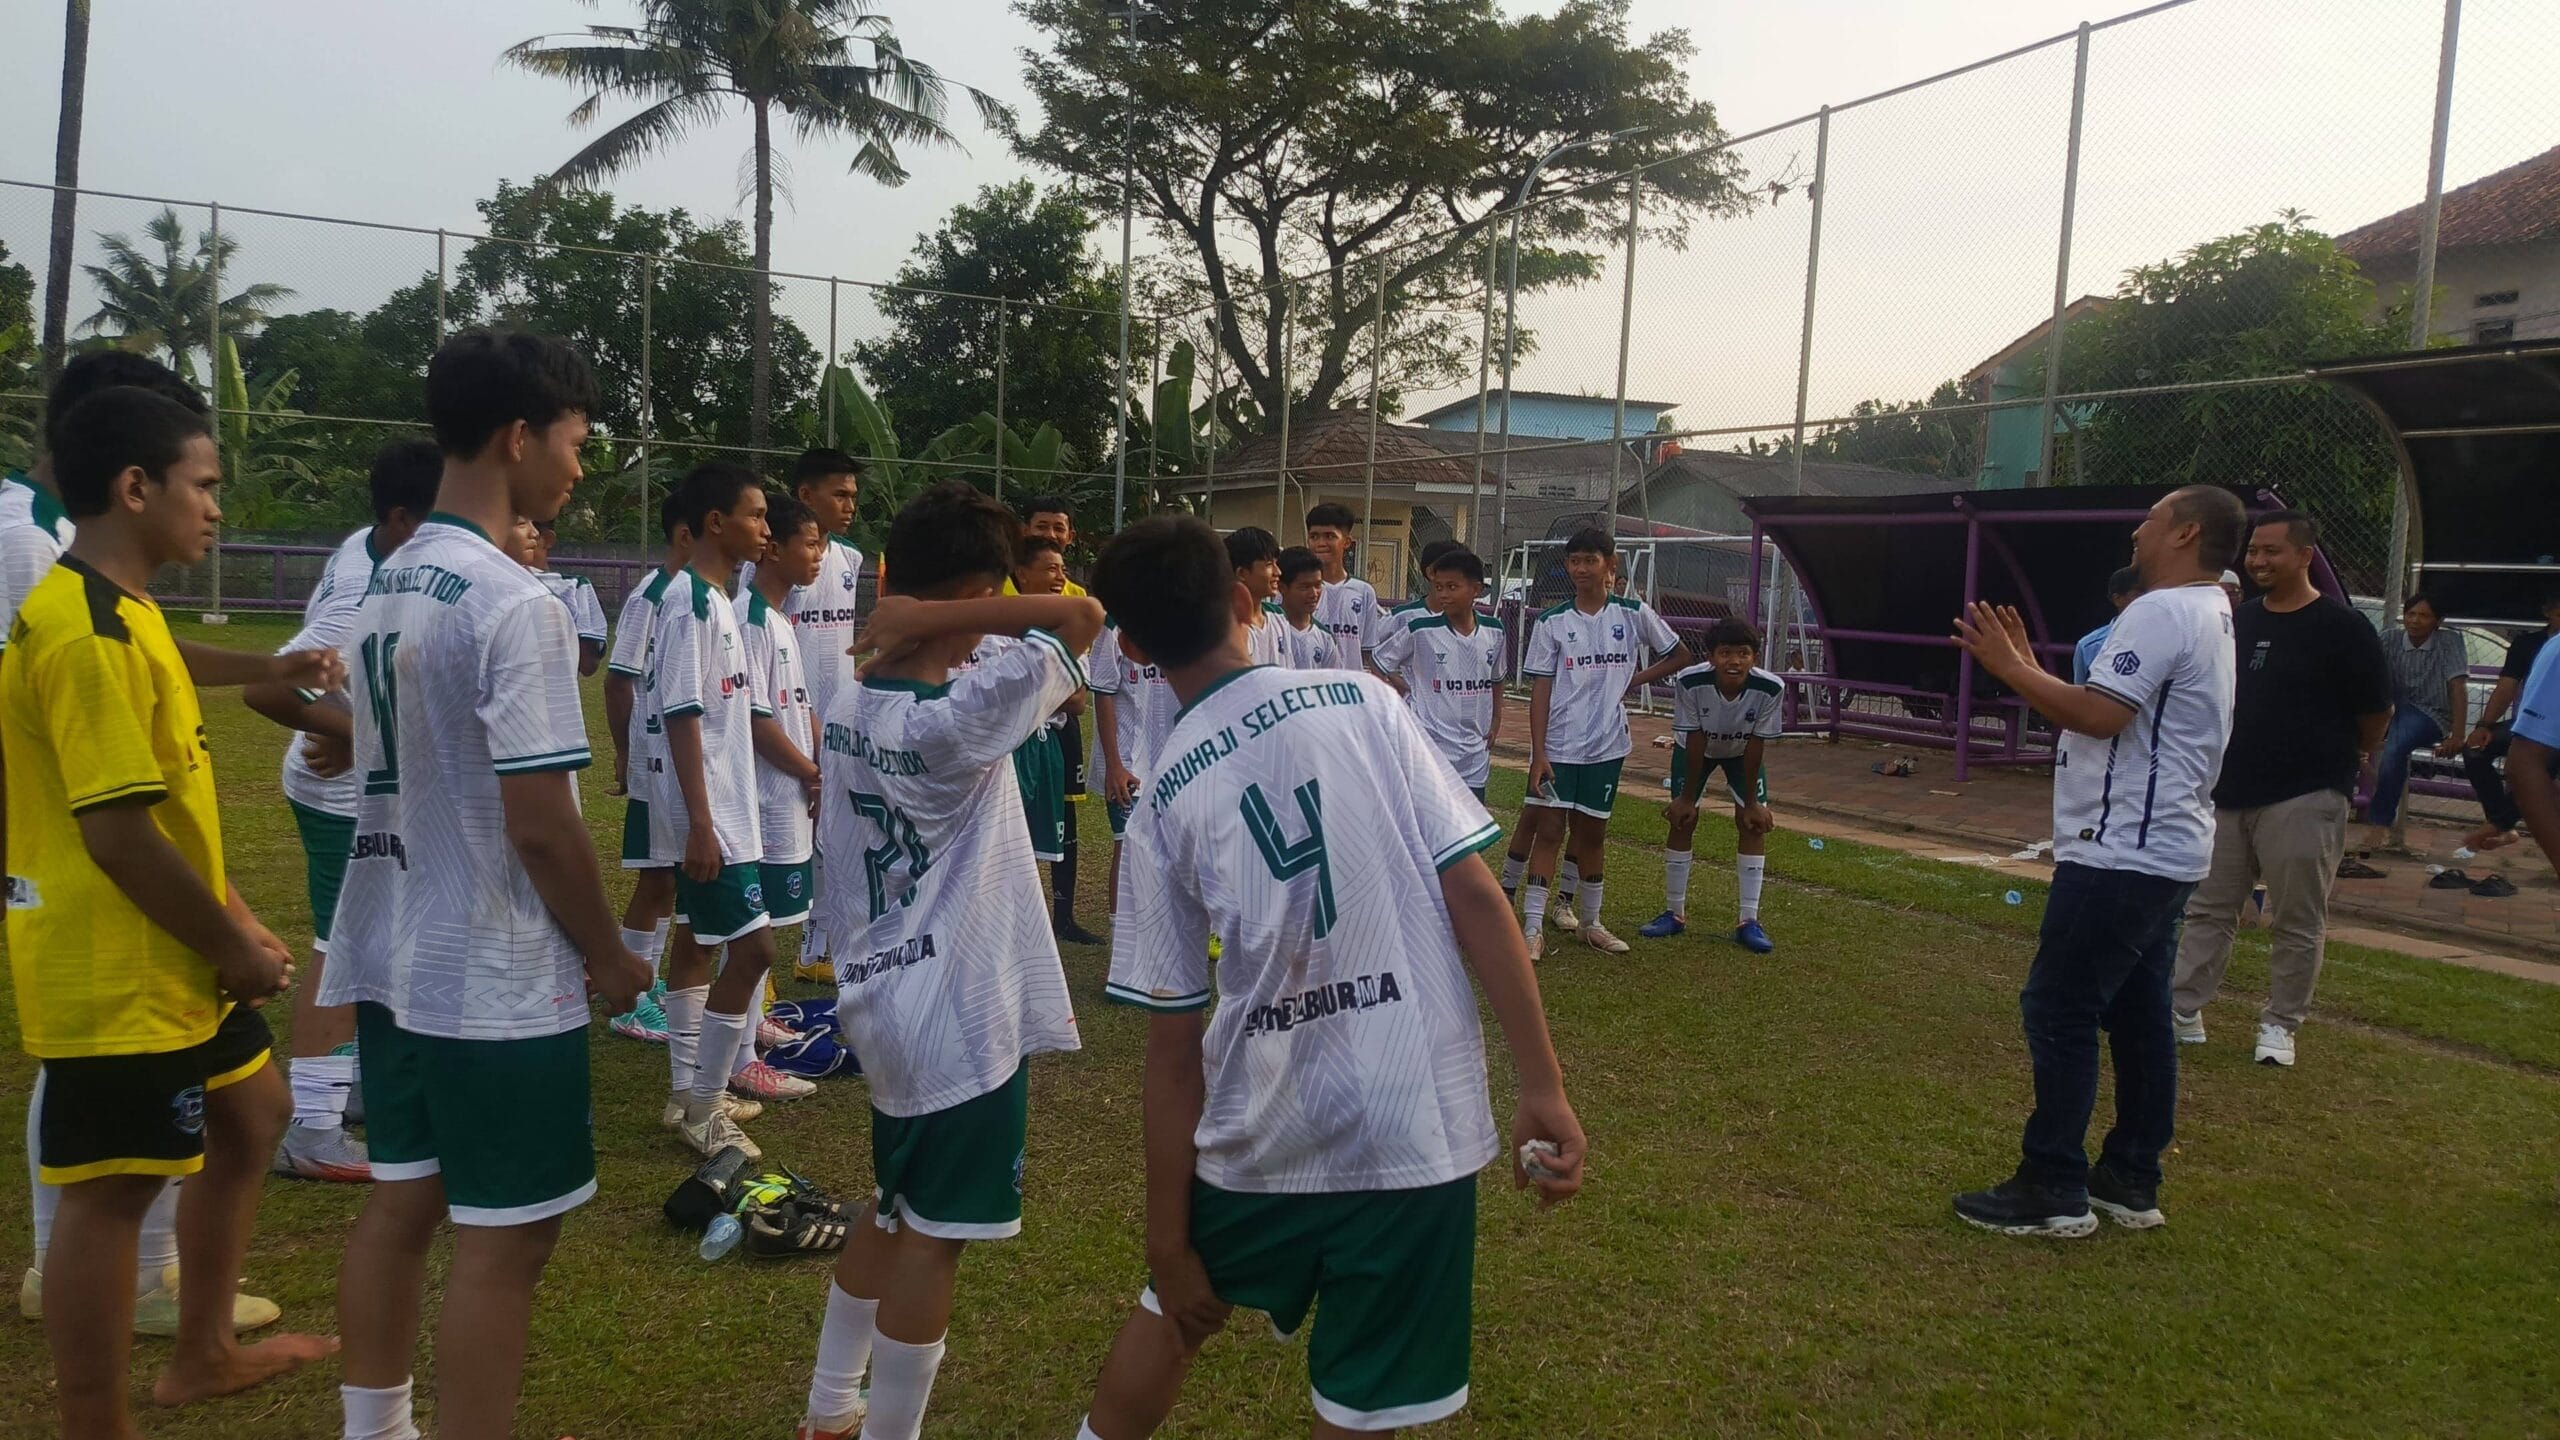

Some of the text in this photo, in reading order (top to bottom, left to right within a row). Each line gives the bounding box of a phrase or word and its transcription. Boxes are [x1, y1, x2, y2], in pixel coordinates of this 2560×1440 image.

[1595, 653, 1628, 665] BLOCK
[1241, 681, 1364, 739] SELECTION
[1604, 783, 1612, 803] 7
[1240, 778, 1338, 940] 4
